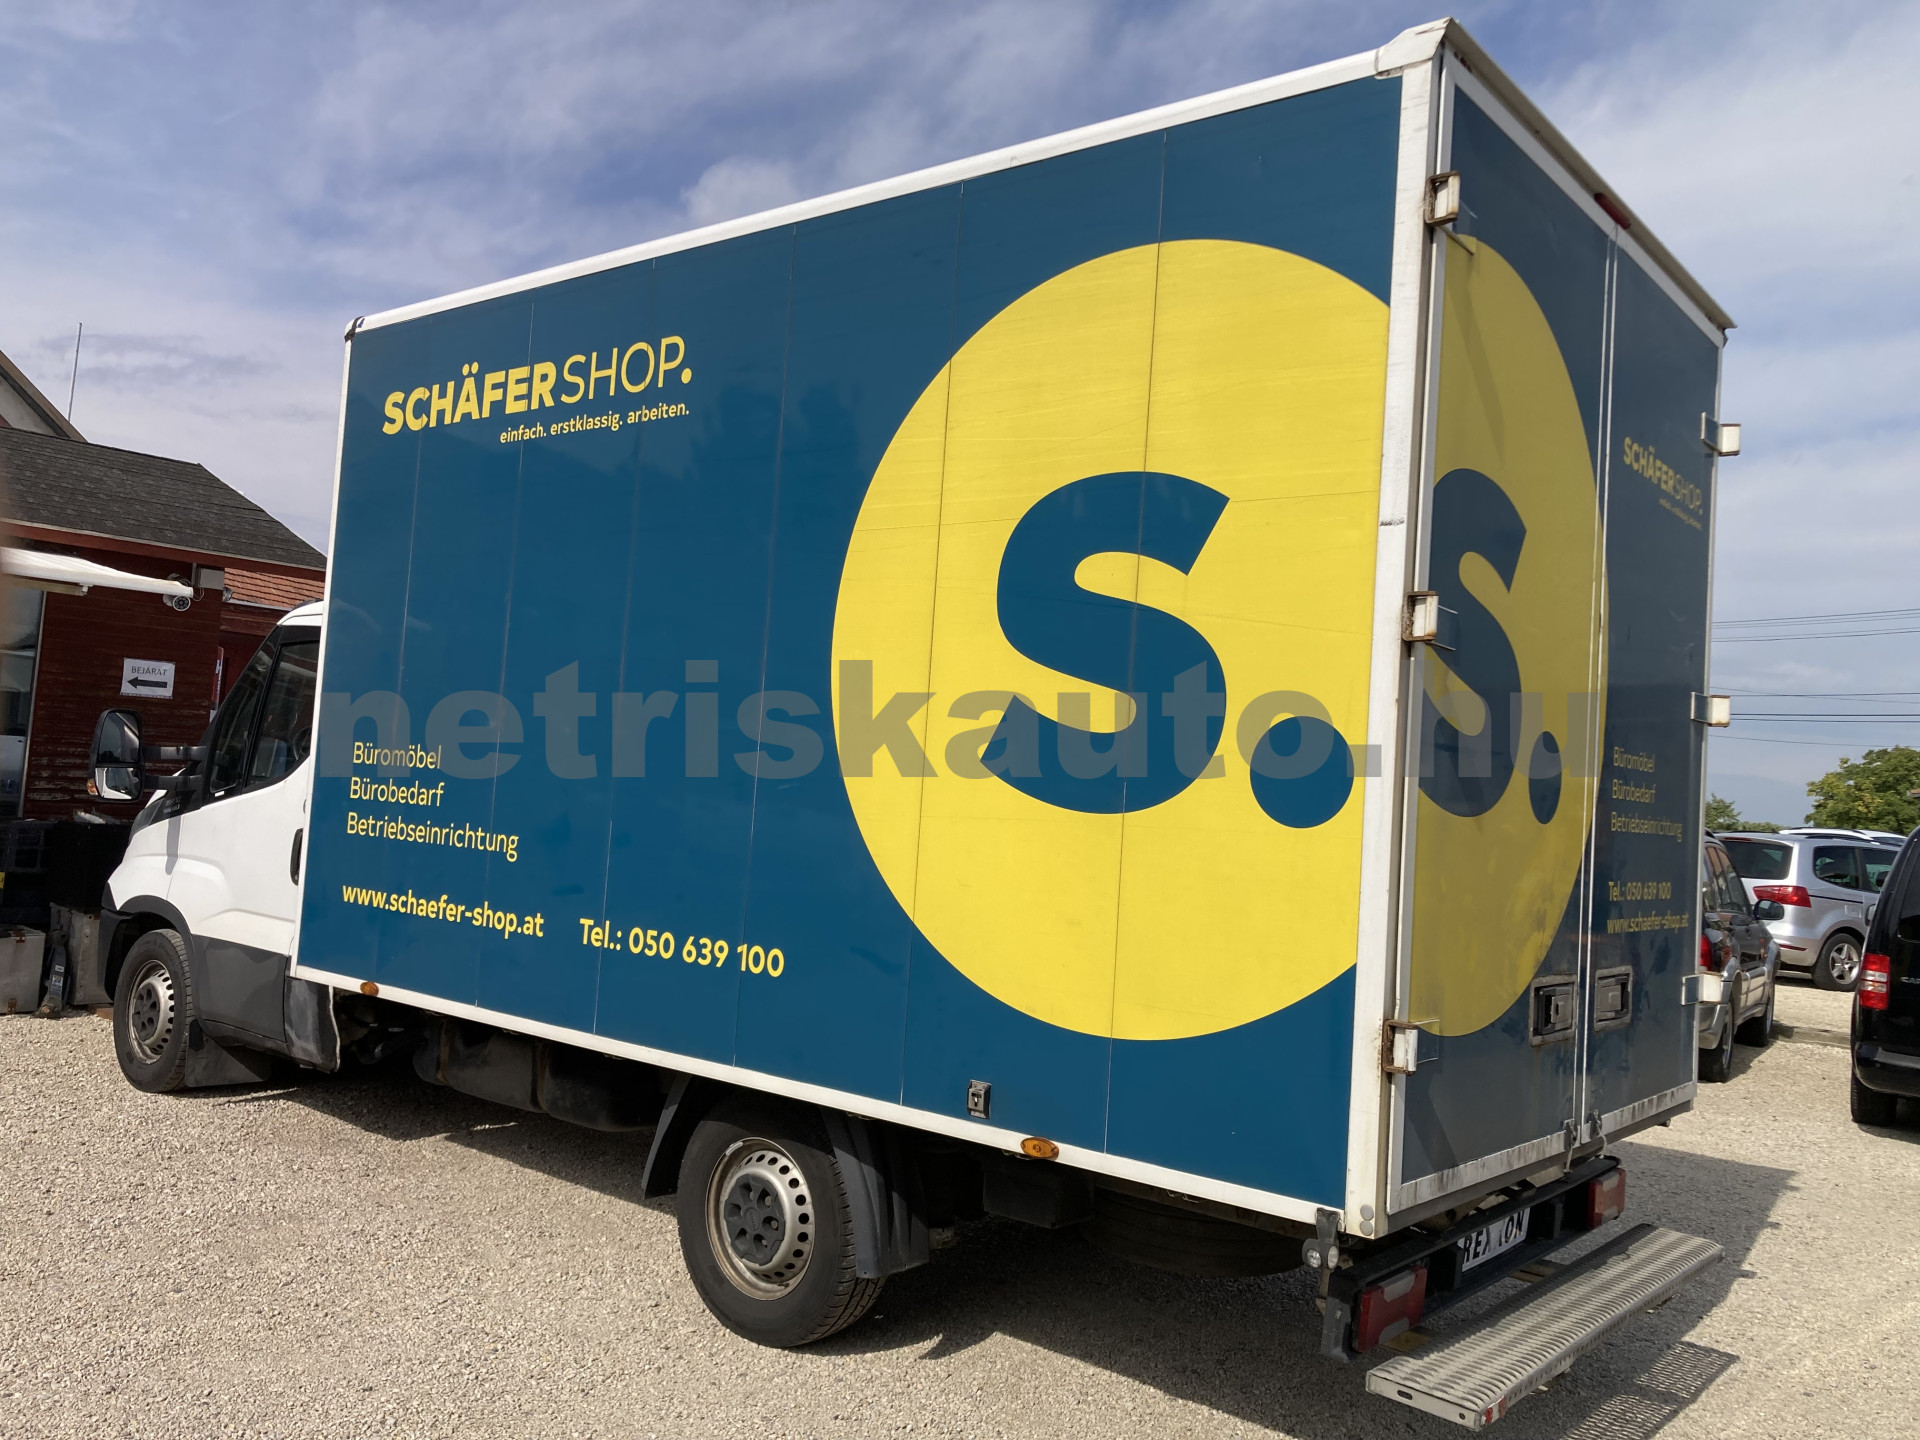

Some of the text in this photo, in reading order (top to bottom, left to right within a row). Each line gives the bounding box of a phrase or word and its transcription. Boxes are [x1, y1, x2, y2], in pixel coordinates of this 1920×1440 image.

[500, 402, 690, 443] einfach. erstklassig. arbeiten.
[131, 666, 168, 677] BEJÁRAT
[352, 741, 442, 770] Büromöbel
[1613, 746, 1656, 773] Büromöbel
[349, 777, 445, 807] Bürobedarf
[1612, 779, 1656, 804] Bürobedarf
[346, 811, 519, 862] Betriebseinrichtung
[1626, 882, 1642, 900] 050
[1658, 882, 1672, 900] 100
[342, 884, 785, 978] www.schaefer-shop.at Tel.: 050 639 100
